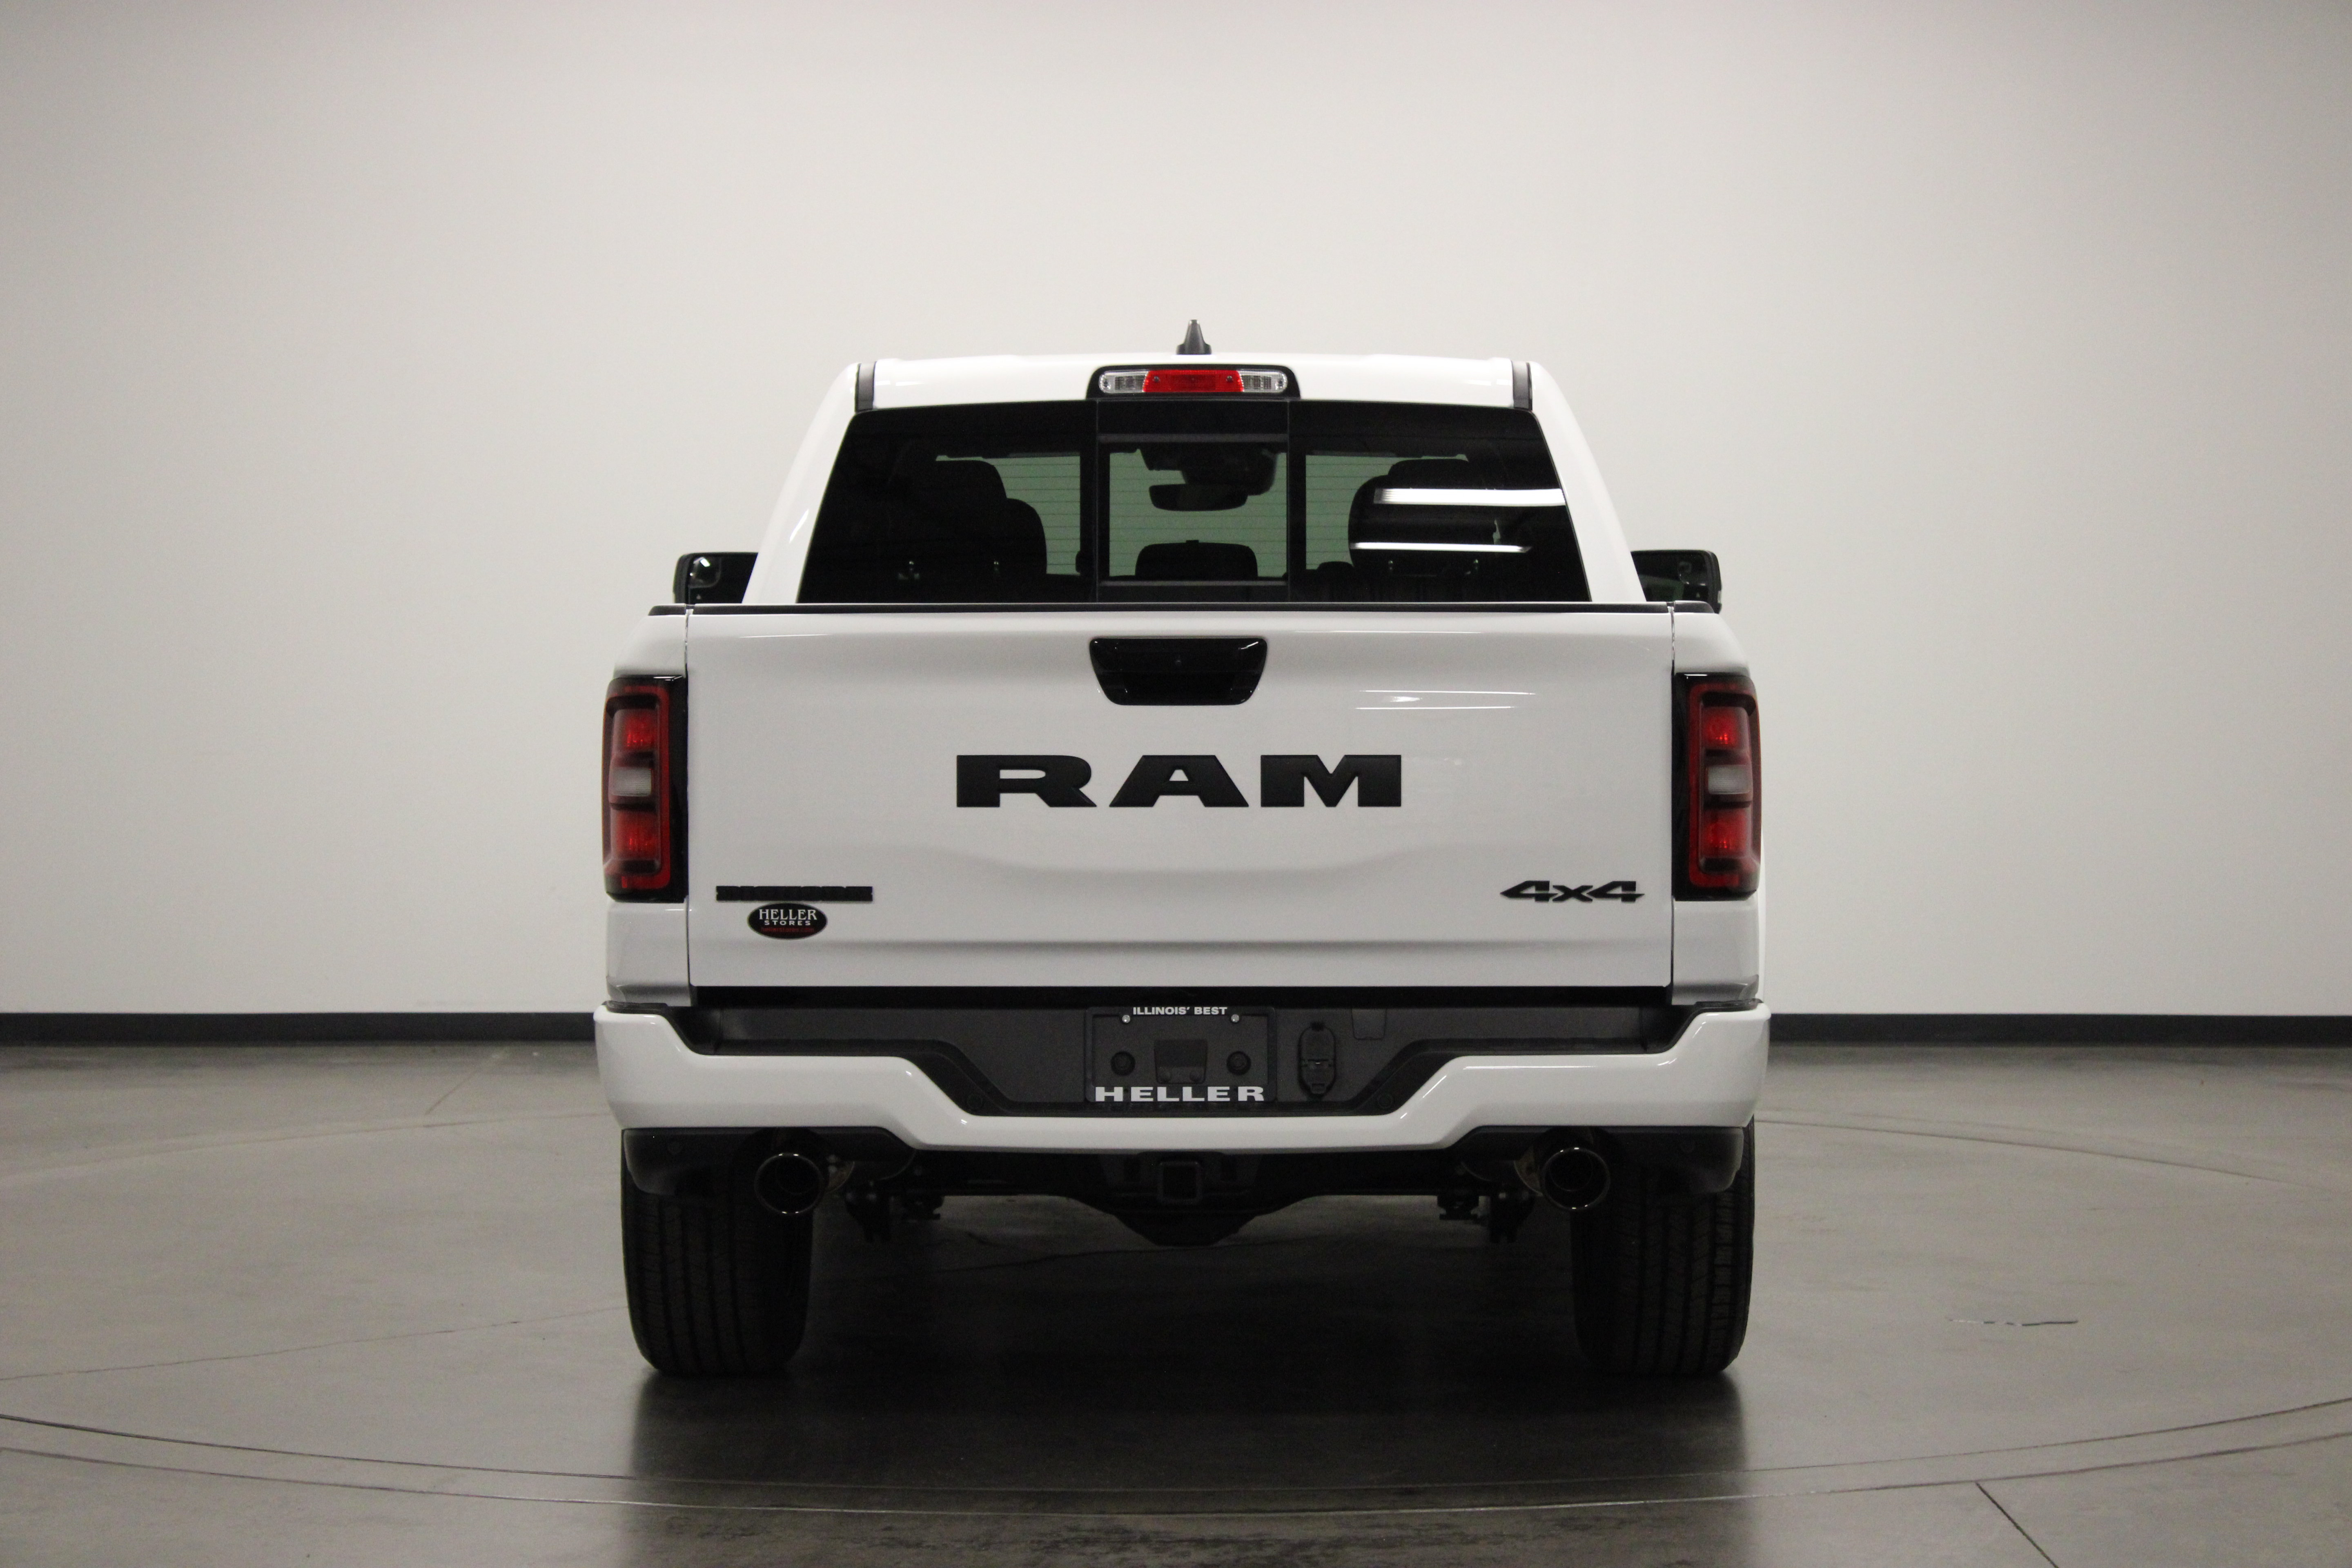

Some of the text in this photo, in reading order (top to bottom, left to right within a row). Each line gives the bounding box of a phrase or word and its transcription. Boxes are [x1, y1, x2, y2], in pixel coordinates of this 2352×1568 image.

[957, 755, 1401, 807] RAM
[1501, 881, 1644, 902] 4x4
[759, 909, 817, 920] HELLER
[1096, 1086, 1264, 1101] HELLER
